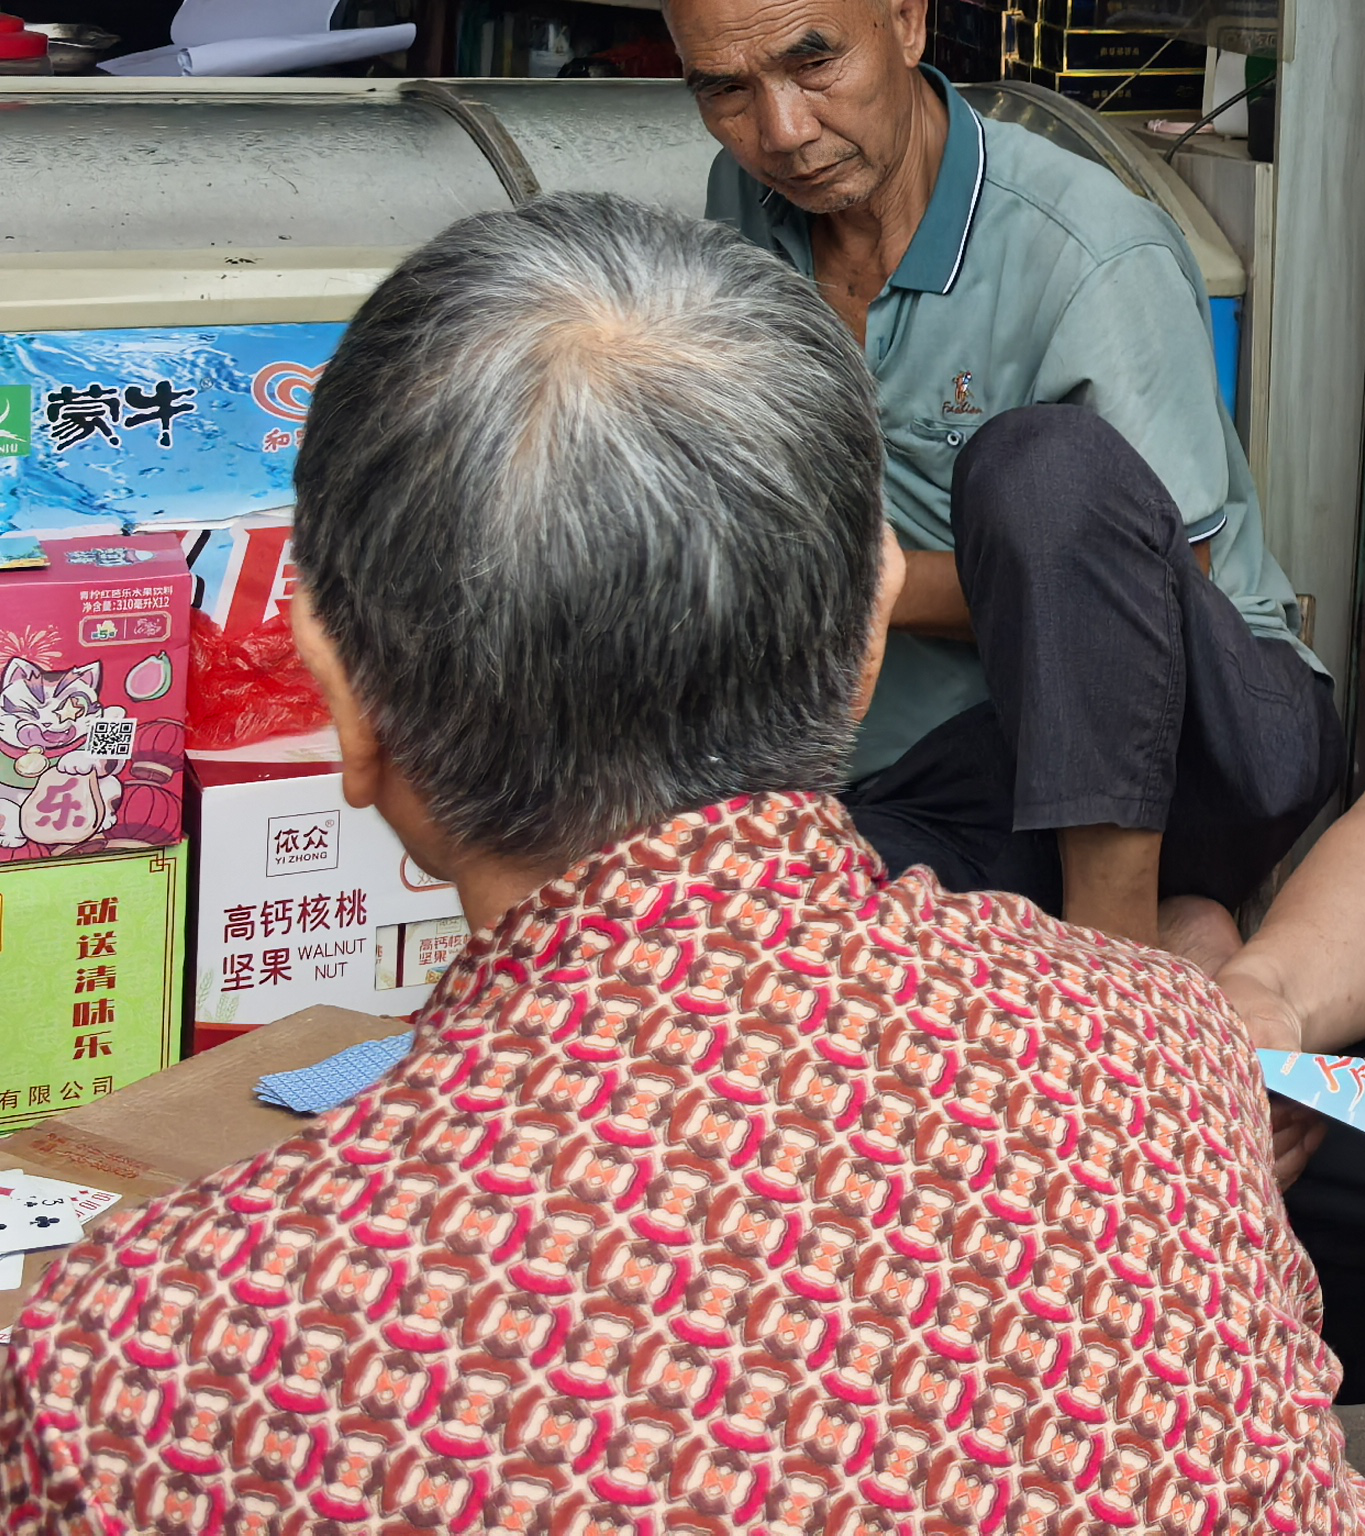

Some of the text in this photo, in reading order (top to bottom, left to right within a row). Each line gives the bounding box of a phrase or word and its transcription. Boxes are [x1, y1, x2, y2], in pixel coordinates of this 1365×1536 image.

[47, 380, 198, 451] 蒙牛
[35, 777, 86, 831] 乐
[274, 825, 328, 854] 依众
[275, 851, 328, 865] YI ZHONG
[223, 888, 367, 944] 高钙核桃
[72, 896, 120, 1061] 就送清味乐
[220, 938, 367, 993] 坚果 WALNUT
[314, 961, 348, 981] NUT
[0, 1075, 114, 1111] 有限公司
